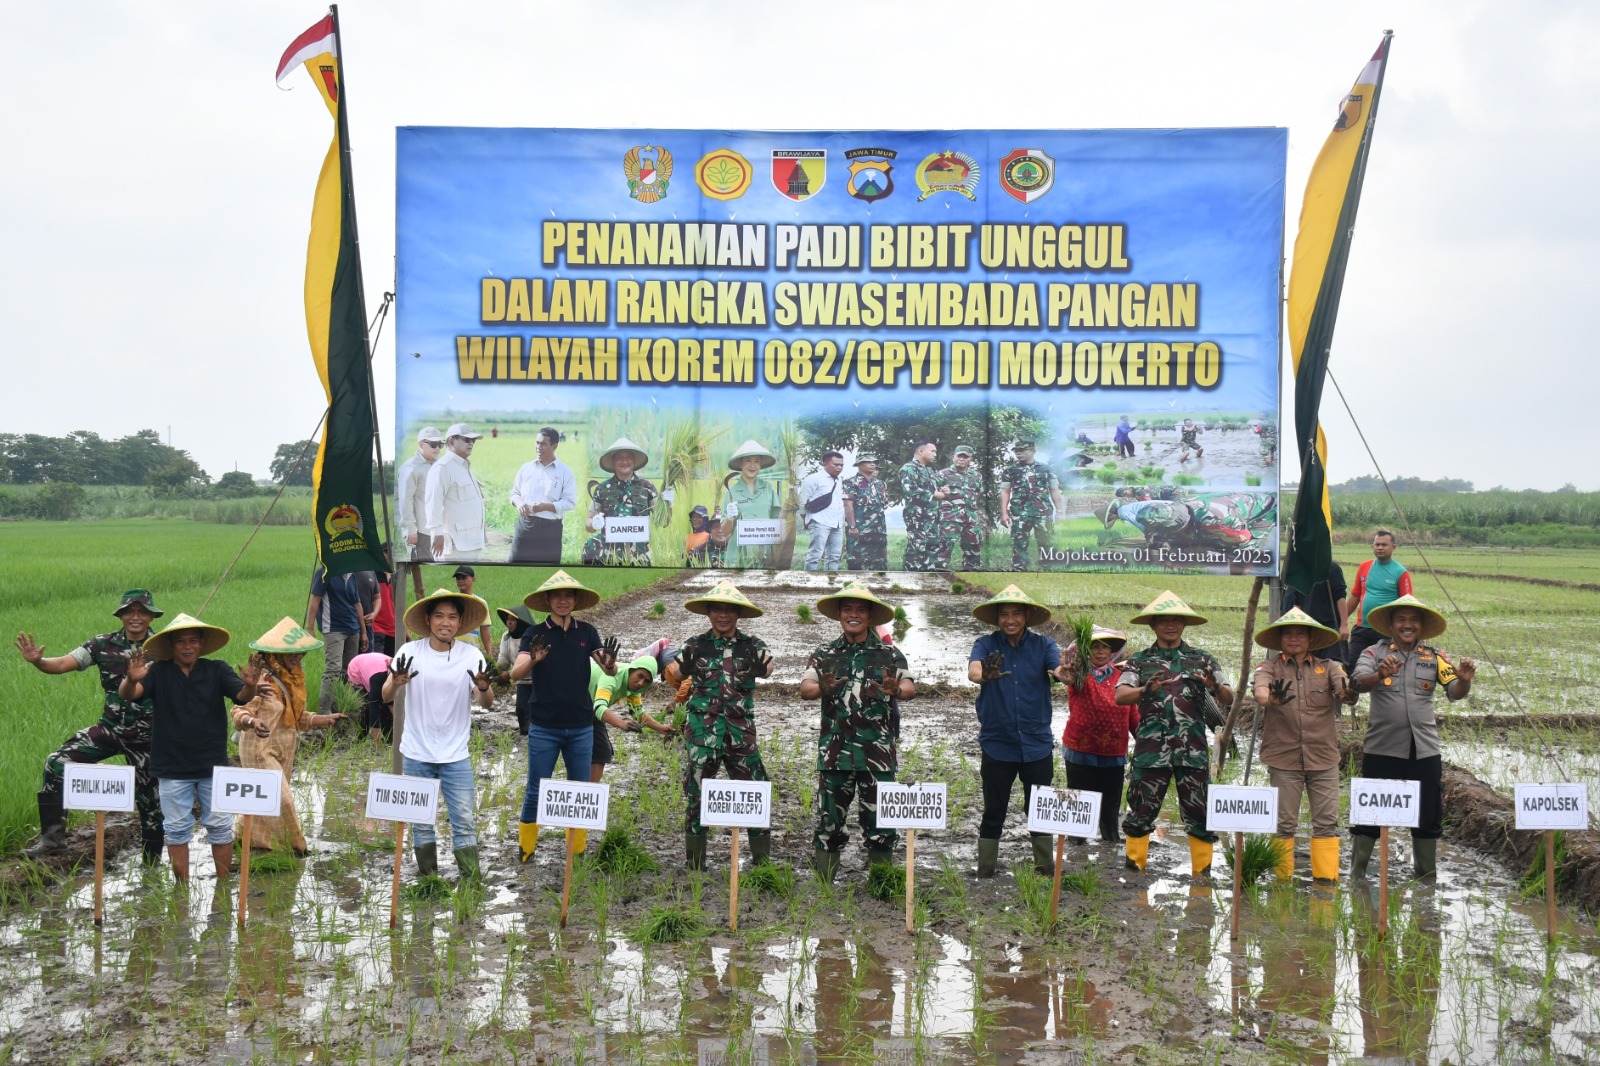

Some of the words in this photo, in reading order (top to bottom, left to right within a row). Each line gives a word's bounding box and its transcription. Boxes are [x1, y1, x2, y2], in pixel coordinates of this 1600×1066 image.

[848, 149, 868, 158] JAWA
[870, 149, 895, 158] TIMUR
[542, 221, 766, 267] PENANAMAN
[775, 225, 860, 268] PADI
[870, 225, 972, 268] BIBIT
[980, 224, 1128, 269] UNGGUL
[481, 278, 607, 322] DALAM
[616, 280, 767, 325] RANGKA
[774, 281, 1040, 327] SWASEMBADA
[1048, 282, 1197, 328] PANGAN
[456, 336, 618, 381] WILAYAH
[627, 337, 754, 383] KOREM
[763, 339, 942, 386] 082/CPYJ
[951, 341, 989, 385] DI
[999, 341, 1220, 387] MOJOKERTO
[610, 525, 645, 534] DANREM
[329, 539, 353, 549] KODIM
[1039, 546, 1127, 565] Mojokerto,
[1133, 548, 1150, 562] 01
[1158, 547, 1227, 563] Februari
[1232, 549, 1272, 564] 2025
[71, 778, 100, 794] PEMILIK
[102, 779, 126, 795] LAHAN
[225, 782, 268, 799] PPL
[375, 788, 390, 804] TIM
[391, 789, 408, 806] SISI
[410, 791, 429, 807] TANI
[546, 789, 572, 804] STAF
[574, 791, 600, 806] AHLI
[708, 790, 736, 802] KASI
[739, 791, 763, 803] TER
[881, 791, 918, 805] KASDIM
[920, 792, 943, 806] 0815
[1036, 796, 1064, 811] BAPAK
[1066, 799, 1092, 814] ANDRI
[1358, 792, 1412, 809] CAMAT
[1522, 796, 1579, 812] KAPOLSEK
[545, 803, 599, 820] WAMENTAN
[707, 802, 731, 814] KOREM
[732, 802, 763, 815] 082/CPYJ
[880, 805, 943, 820] MOJOKERTO
[1214, 799, 1270, 816] DANRAMIL
[1036, 808, 1051, 821] TIM
[1052, 809, 1069, 823] SISI
[1071, 811, 1091, 825] TANI
